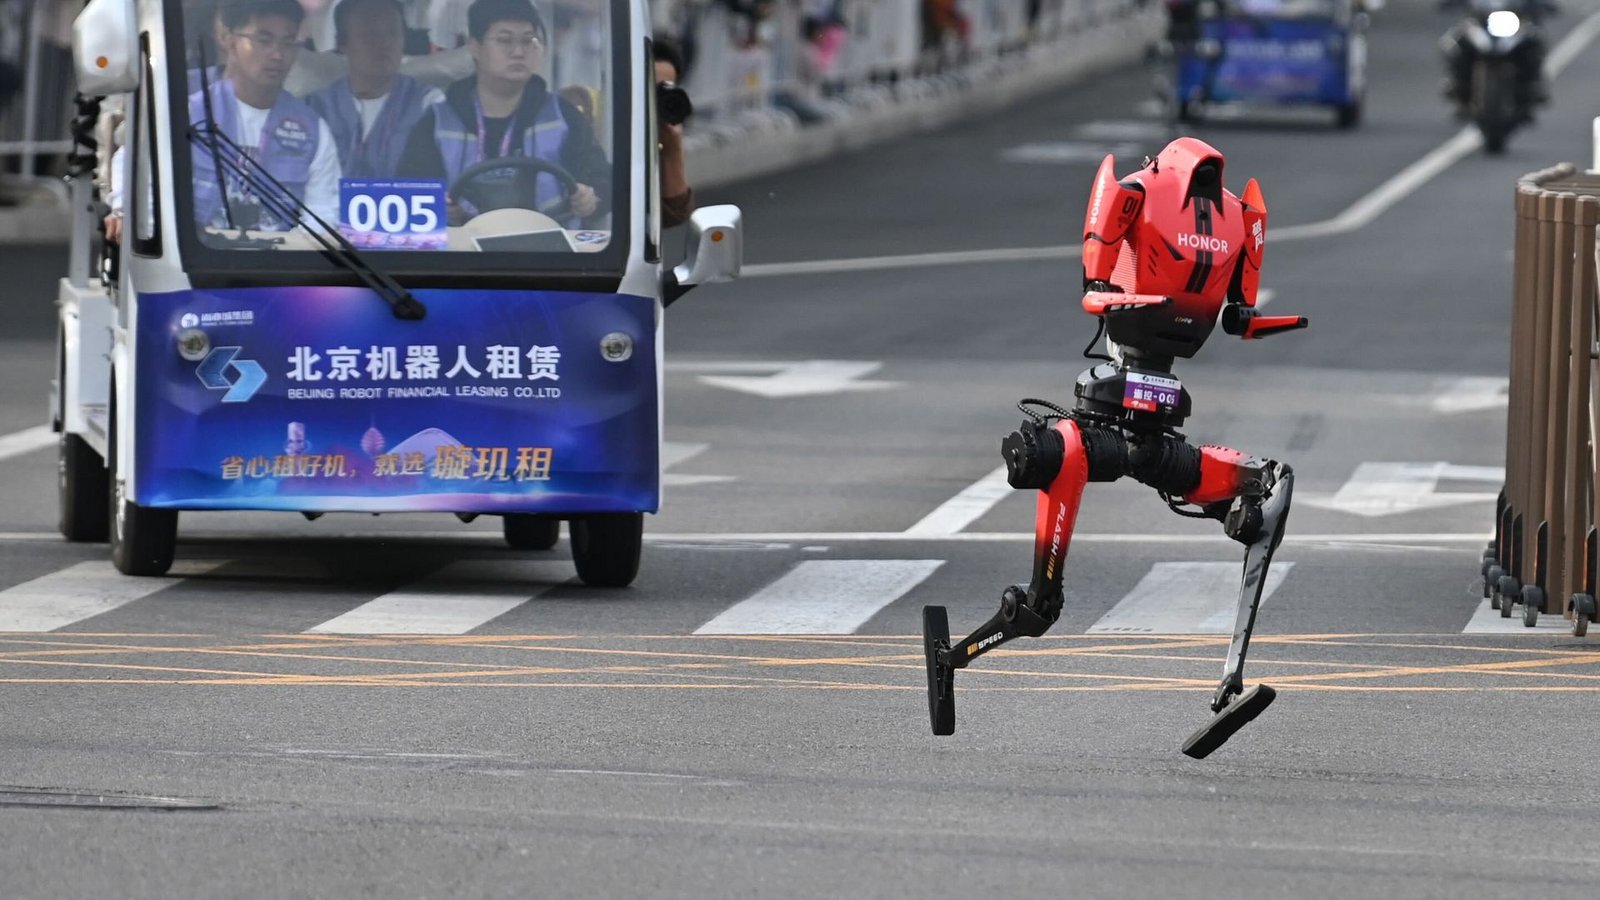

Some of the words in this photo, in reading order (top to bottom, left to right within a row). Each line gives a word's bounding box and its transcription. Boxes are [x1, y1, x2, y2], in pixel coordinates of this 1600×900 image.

[348, 194, 437, 232] 005
[1090, 177, 1105, 225] HONOR
[1178, 232, 1228, 254] HONOR
[286, 345, 560, 381] 北京机器人租赁
[287, 388, 334, 399] BEIJING
[340, 387, 382, 399] ROBOT
[387, 386, 450, 398] FINANCIAL
[455, 385, 508, 397] LEASING
[1051, 502, 1066, 556] FLASH
[978, 631, 1004, 650] SPEED
